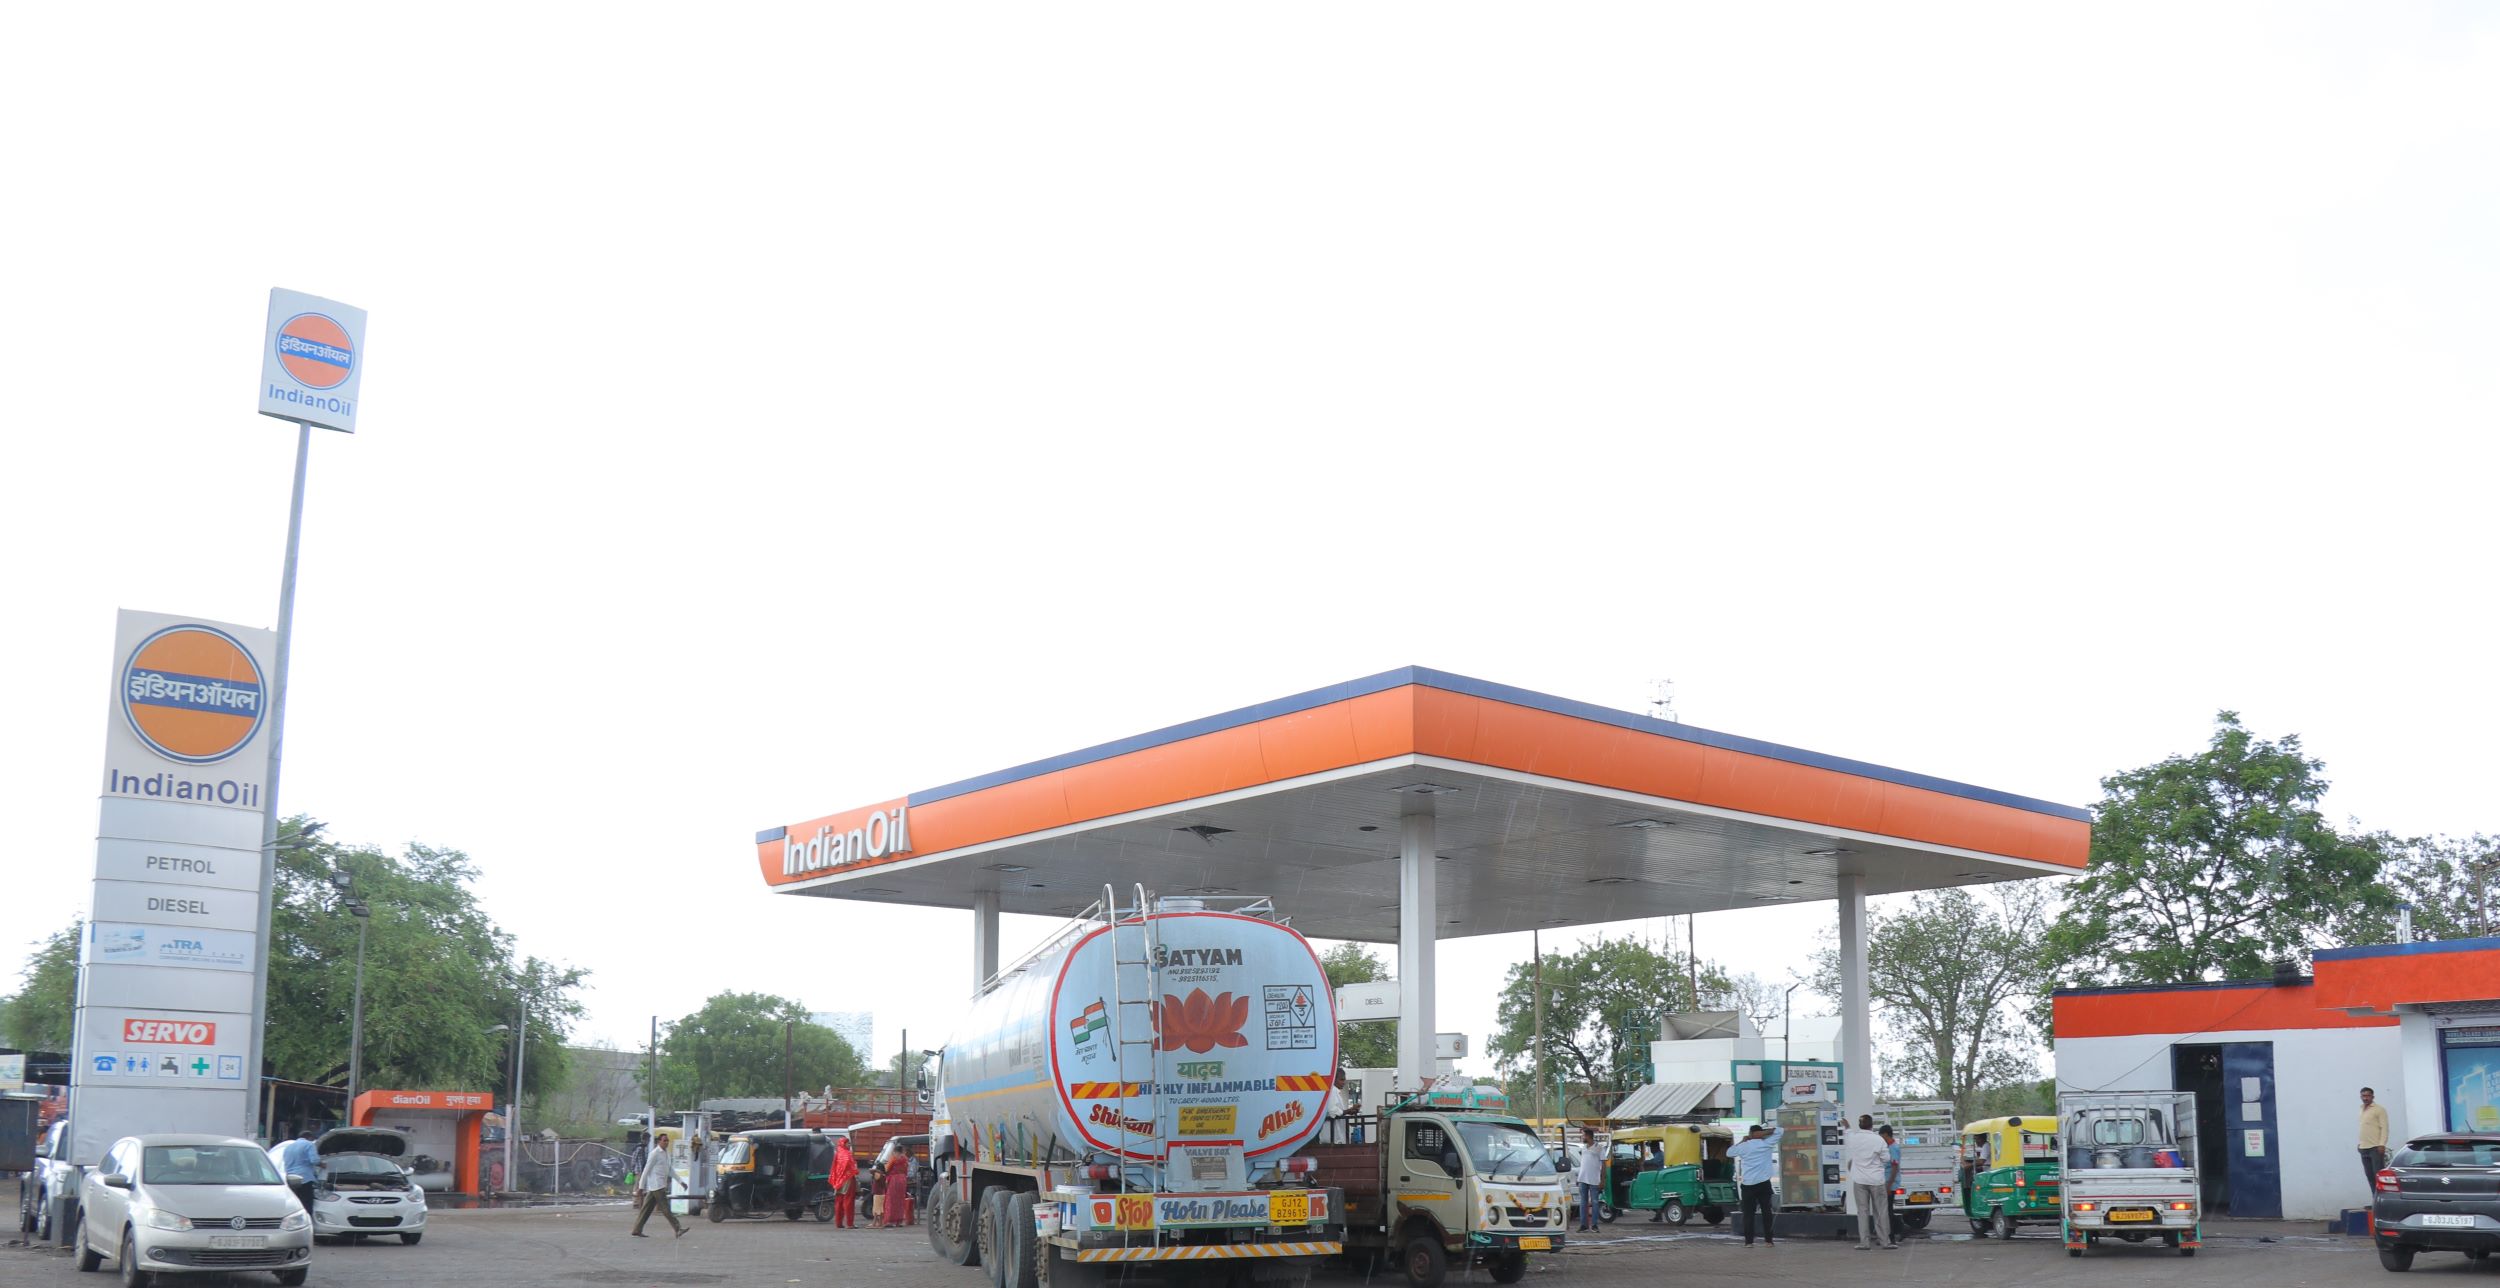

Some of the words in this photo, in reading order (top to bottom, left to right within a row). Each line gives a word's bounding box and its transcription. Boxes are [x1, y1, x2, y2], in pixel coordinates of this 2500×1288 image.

[280, 336, 350, 364] इंडियनऑयल
[268, 384, 351, 416] IndianOil
[130, 671, 258, 710] इंडियनऑयल
[110, 768, 259, 807] IndianOil
[783, 806, 911, 876] IndianOil
[146, 856, 216, 874] PETROL
[147, 897, 209, 914] DIESEL
[1154, 947, 1243, 968] SATYAM
[1298, 1007, 1306, 1017] 3
[127, 1021, 208, 1043] SERVO
[1177, 1061, 1225, 1080] यादव
[1139, 1082, 1184, 1095] HIGHLY
[1187, 1078, 1276, 1094] INFLAMMABLE
[1117, 1197, 1153, 1227] Stop
[1161, 1200, 1207, 1221] Horn
[1281, 1198, 1302, 1207] GJ12
